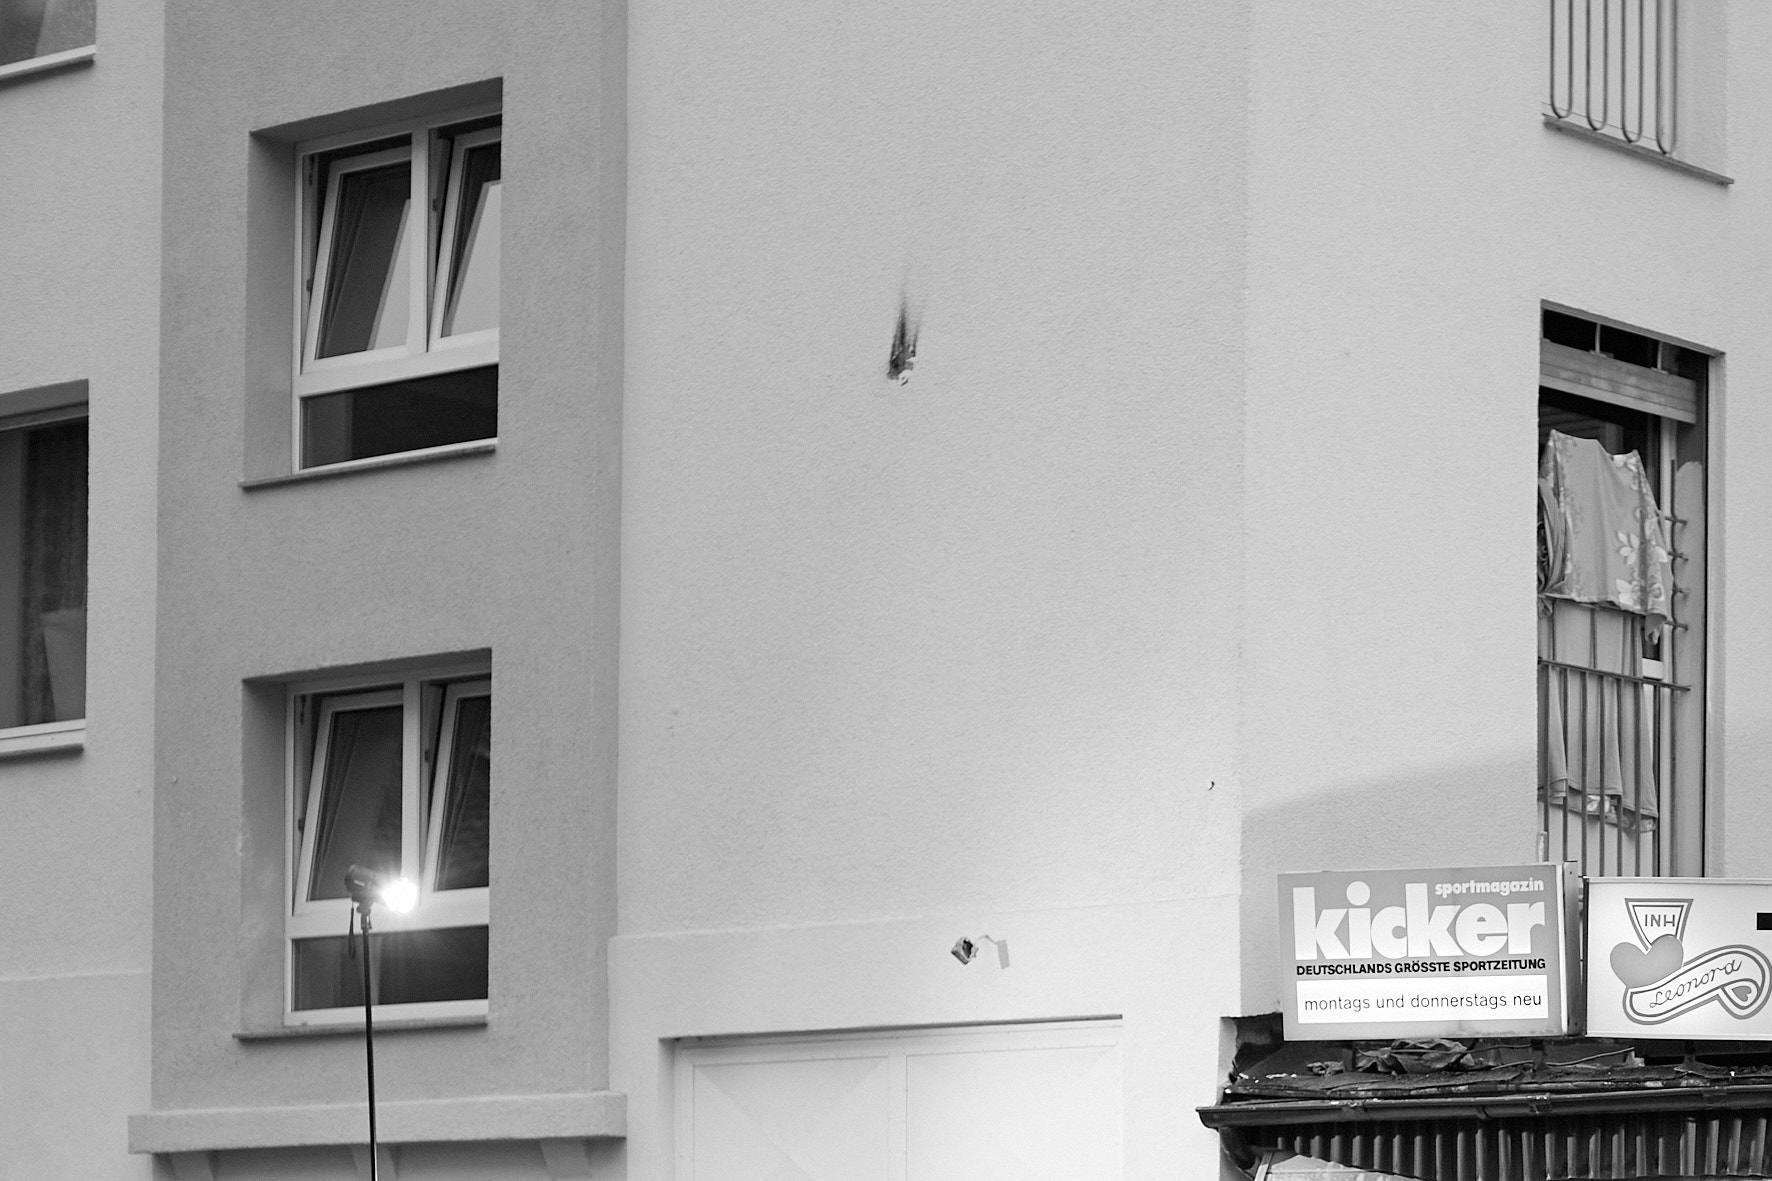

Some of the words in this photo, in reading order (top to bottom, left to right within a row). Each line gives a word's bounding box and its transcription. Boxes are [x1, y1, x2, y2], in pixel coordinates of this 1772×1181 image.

[1434, 877, 1544, 899] sportmagazin
[1292, 880, 1546, 960] kicker
[1644, 913, 1676, 928] INH
[1296, 962, 1392, 976] DEUTSCHLANDS
[1394, 960, 1451, 974] GRÖSSTE
[1452, 957, 1547, 972] SPORTZEITUNG
[1649, 959, 1743, 1009] Leonora
[1304, 995, 1371, 1013] montags
[1376, 994, 1405, 1009] und
[1410, 993, 1507, 1010] donnerstags
[1512, 993, 1542, 1007] neu
